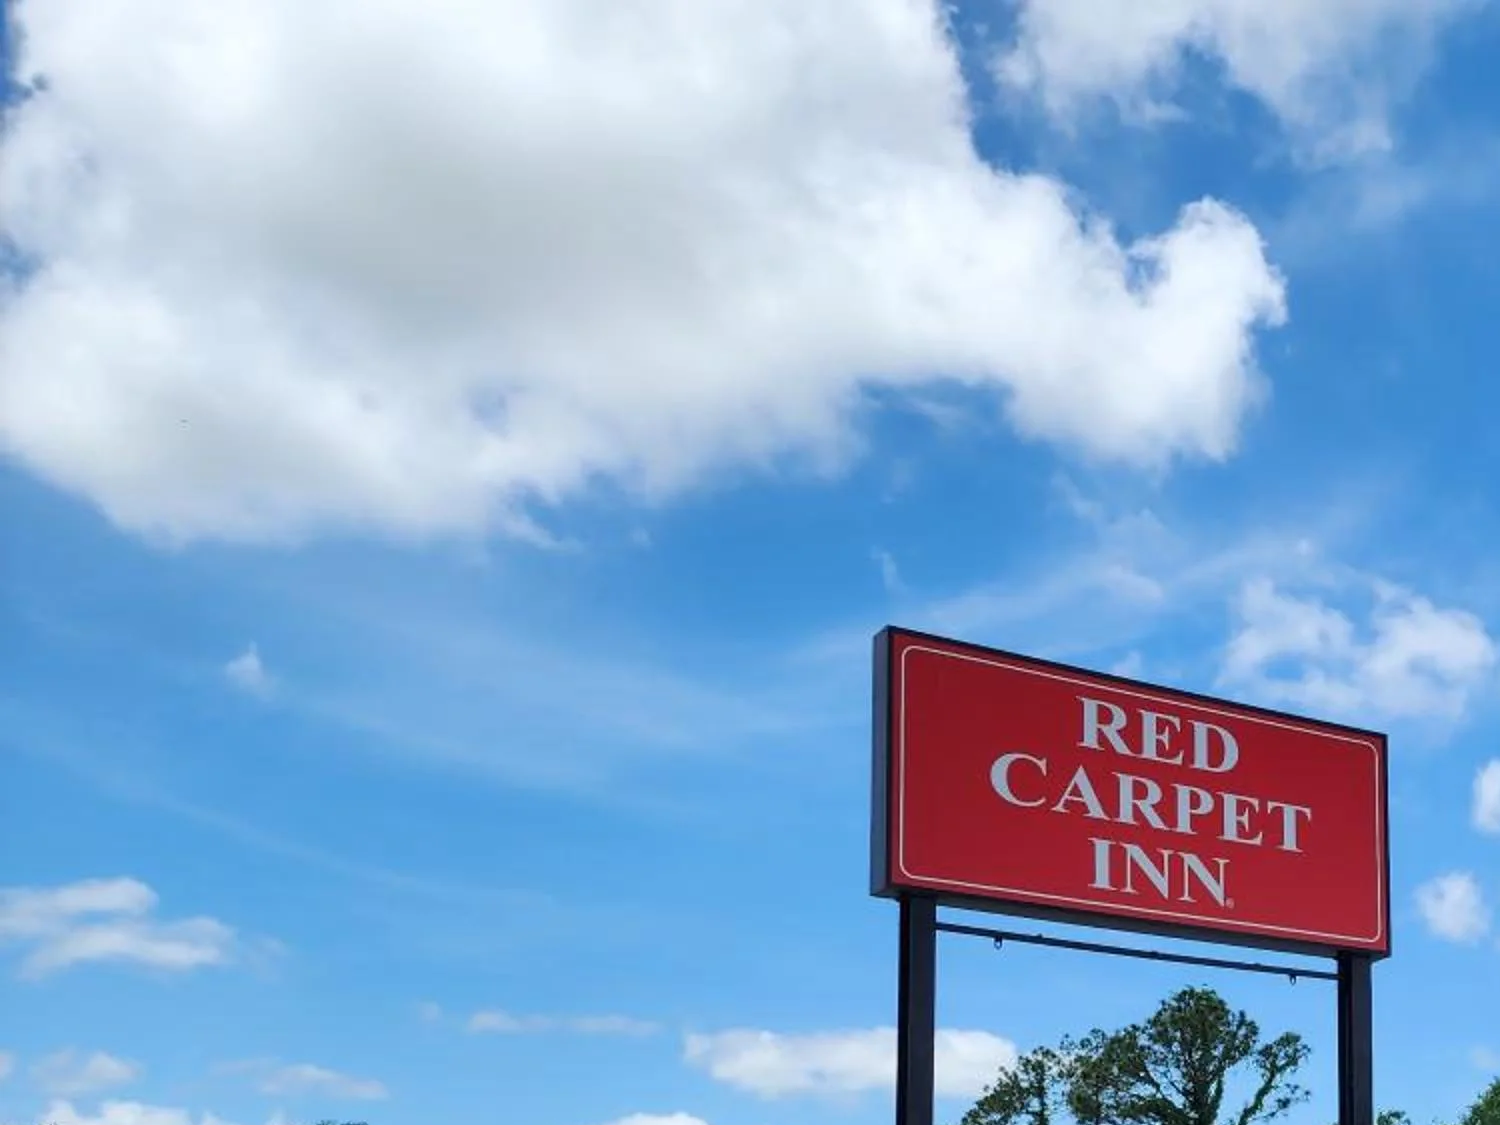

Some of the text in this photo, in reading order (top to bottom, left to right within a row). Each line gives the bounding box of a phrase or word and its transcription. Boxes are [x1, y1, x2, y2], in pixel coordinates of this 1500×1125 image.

[1076, 696, 1240, 774] RED
[989, 752, 1312, 853] CARPET
[1088, 837, 1231, 909] INN
